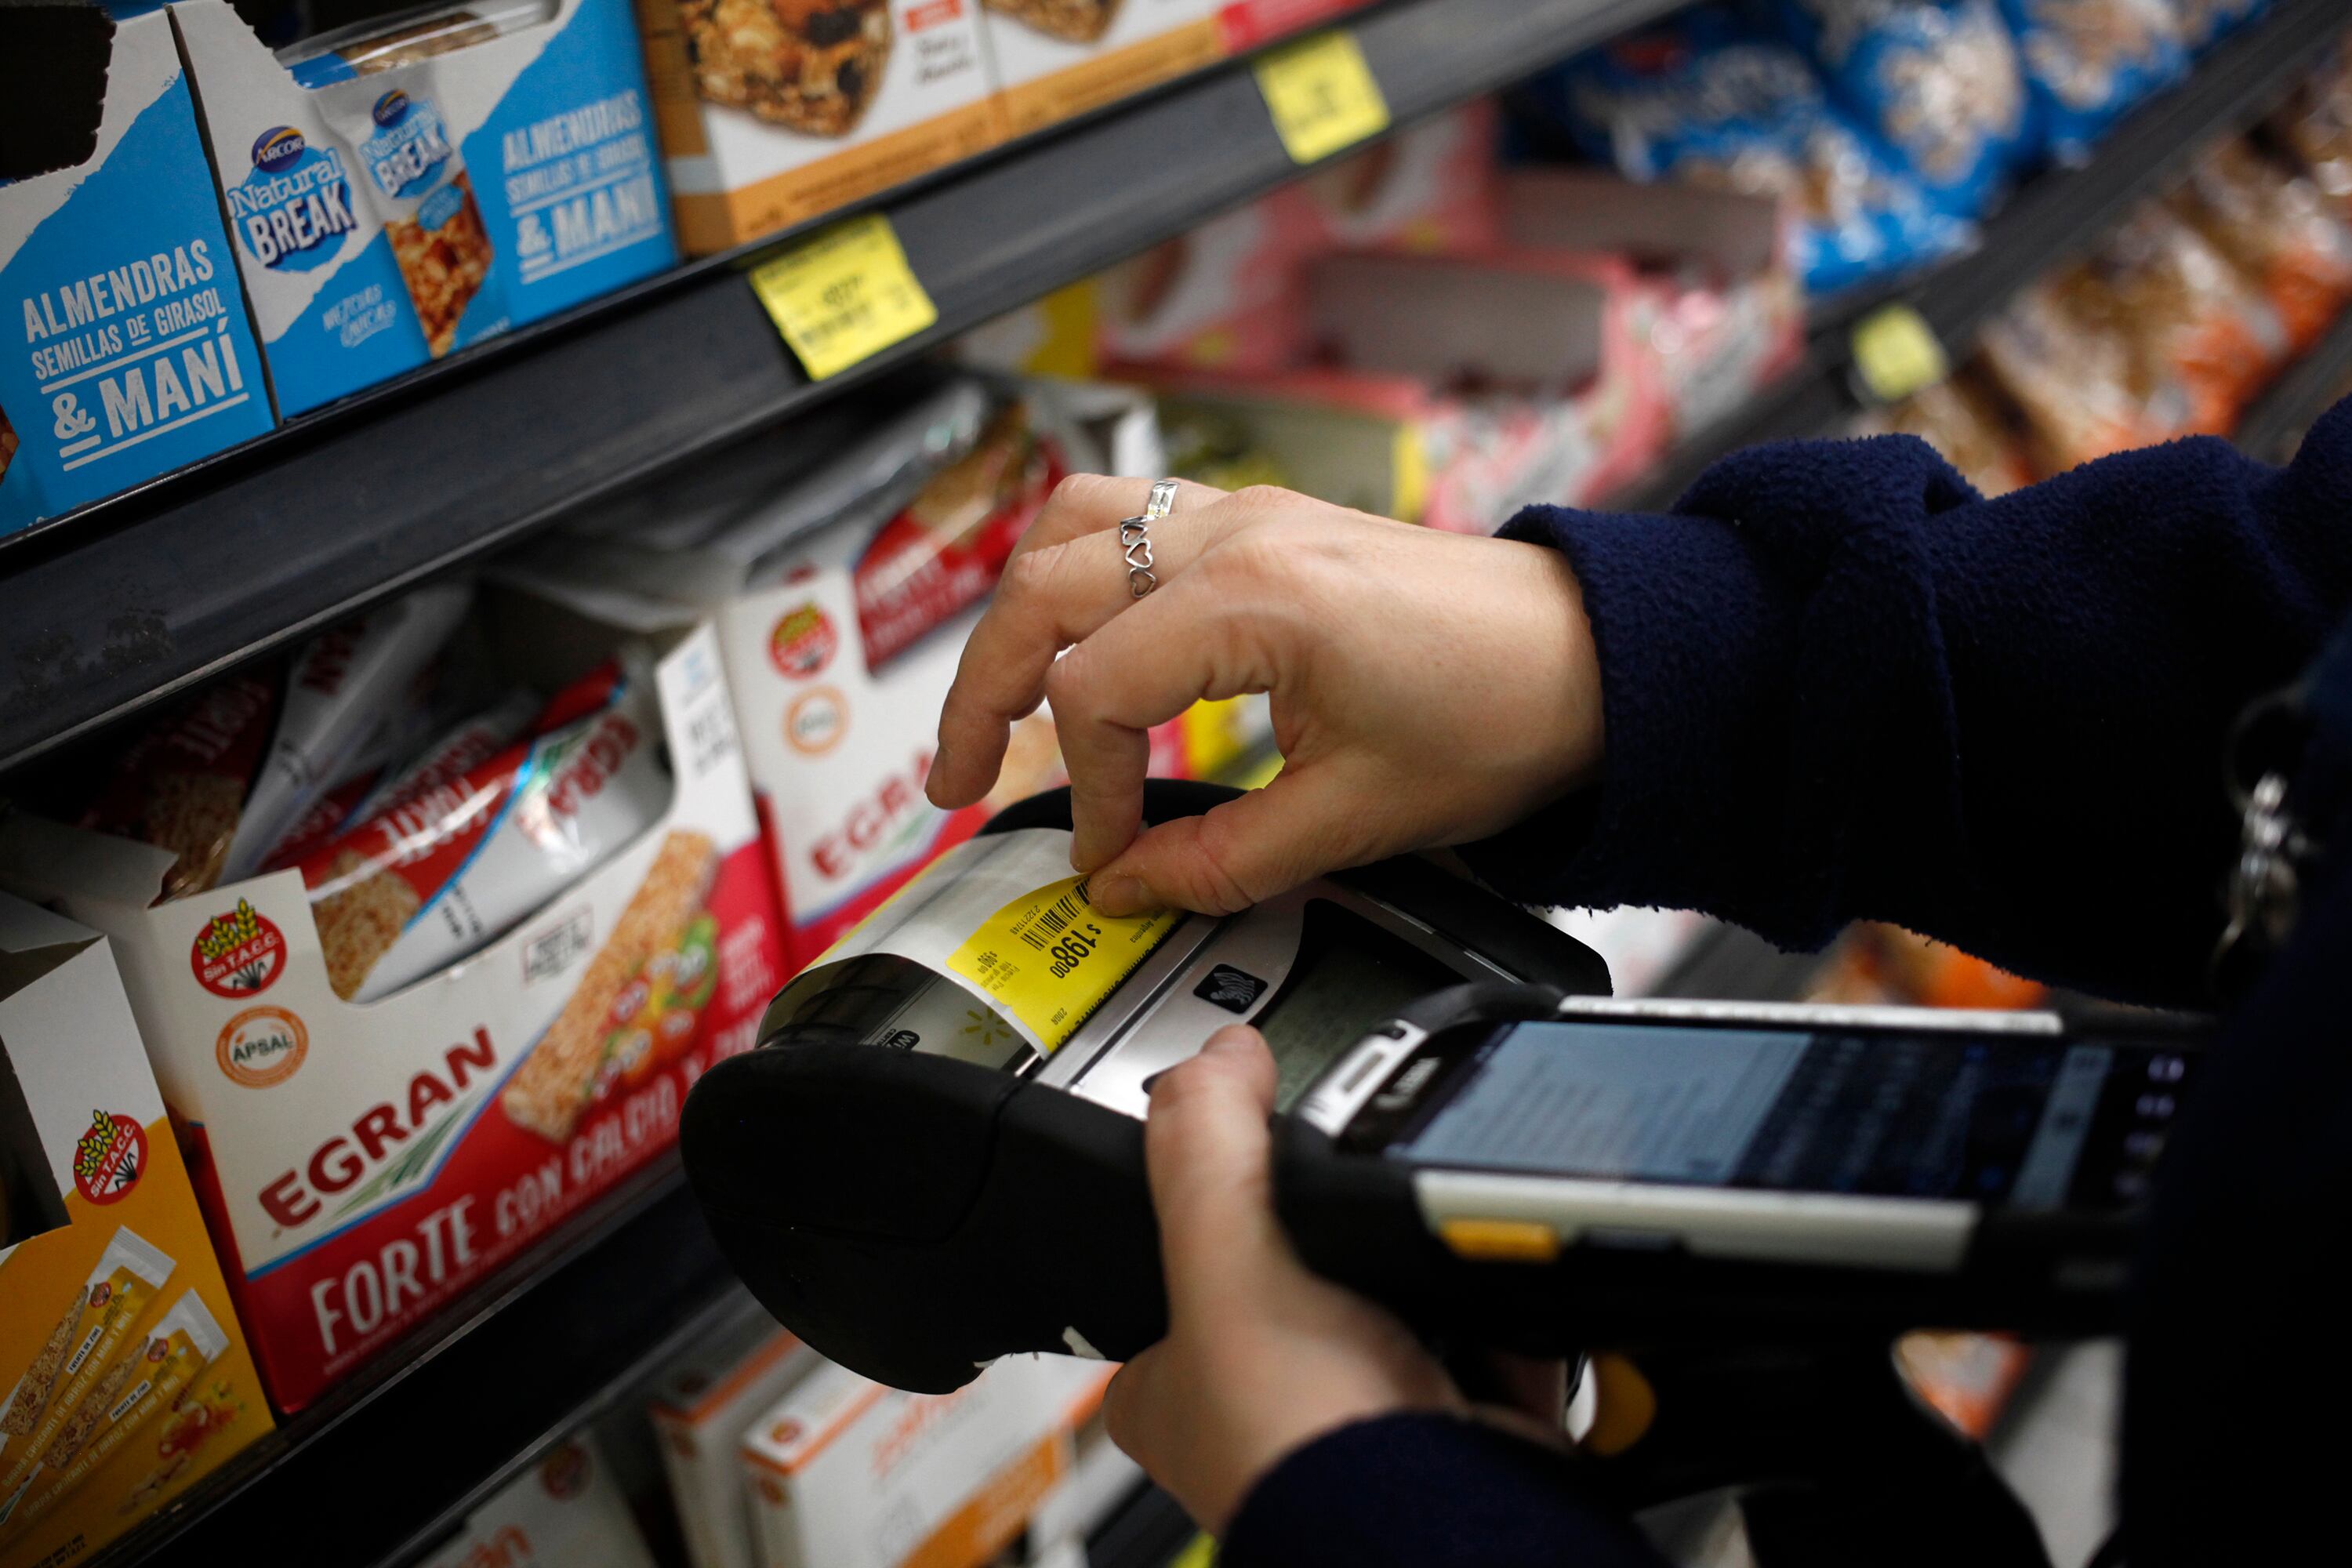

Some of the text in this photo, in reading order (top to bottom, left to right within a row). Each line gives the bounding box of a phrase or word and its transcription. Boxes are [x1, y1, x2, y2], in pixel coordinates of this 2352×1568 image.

[228, 149, 343, 218] Natural
[256, 135, 307, 165] ARCOR
[246, 181, 353, 265] BREAK
[23, 238, 213, 343] ALMENDRAS
[31, 287, 226, 380] SEMILLAS DE GIRASOL
[52, 316, 244, 440] & MANÍ
[203, 964, 227, 982] Sin
[233, 1033, 294, 1062] APSAL
[258, 1023, 496, 1228] EGRAN
[90, 1174, 107, 1198] Sin
[310, 1195, 476, 1356] FORTE
[495, 1156, 564, 1236] CON
[570, 1072, 681, 1181] CALCIO
[3, 1457, 29, 1487] BARRA
[27, 1417, 60, 1459] CROCANTE
[64, 1378, 86, 1406] ARROZ
